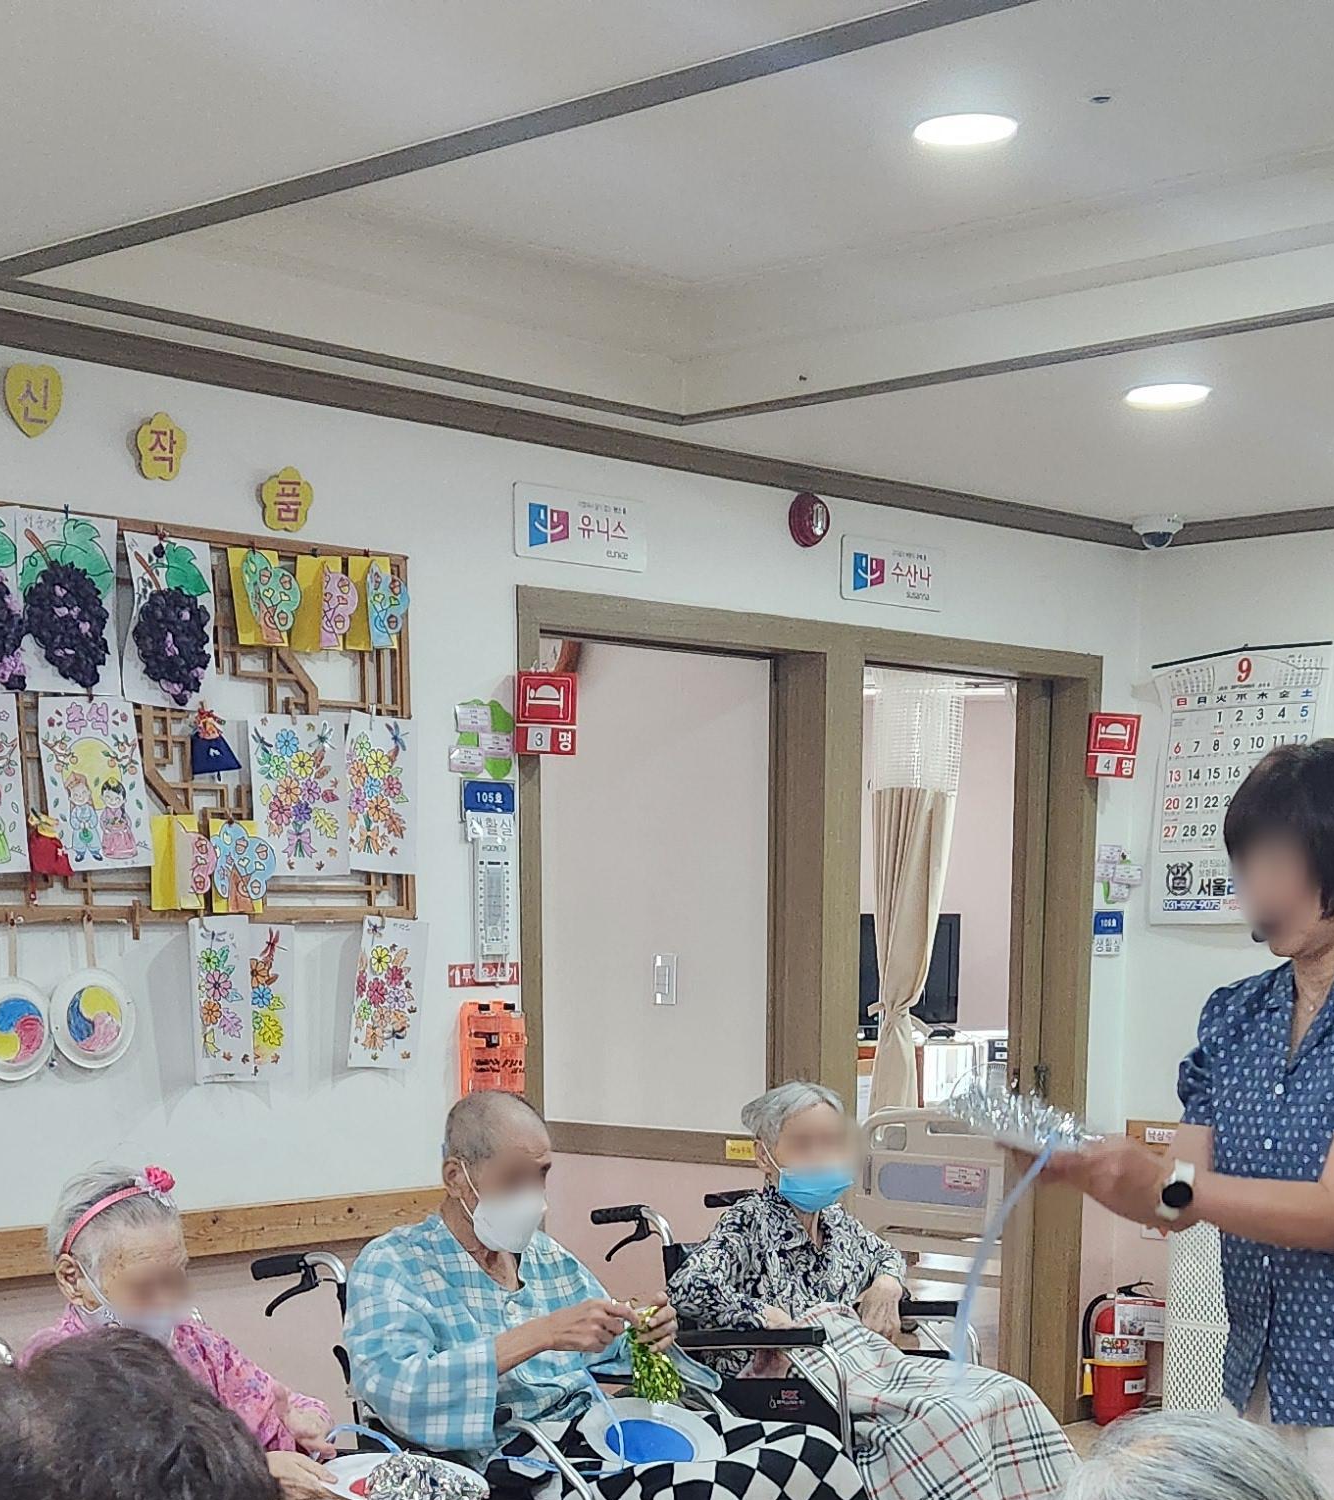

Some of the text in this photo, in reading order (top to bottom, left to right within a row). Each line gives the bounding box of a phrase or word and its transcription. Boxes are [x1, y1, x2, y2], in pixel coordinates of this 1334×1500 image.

[148, 429, 302, 523] 작품
[577, 515, 629, 542] 유니스
[891, 562, 931, 588] 수산나
[1237, 657, 1252, 683] 9
[1215, 693, 1227, 703] 火
[1256, 691, 1268, 700] 木
[1300, 688, 1313, 698] 土
[66, 702, 109, 736] 추석
[1217, 705, 1309, 722] 1 2 3 4 5
[534, 731, 572, 752] 3 명
[1174, 734, 1308, 754] 6 7 8 9 10 11 12
[1103, 759, 1134, 776] 4 명
[1169, 766, 1240, 782] 13 14 15 16
[476, 792, 503, 803] 105호
[1165, 795, 1232, 810] 20 21 22 2
[1163, 824, 1217, 838] 27 28 29
